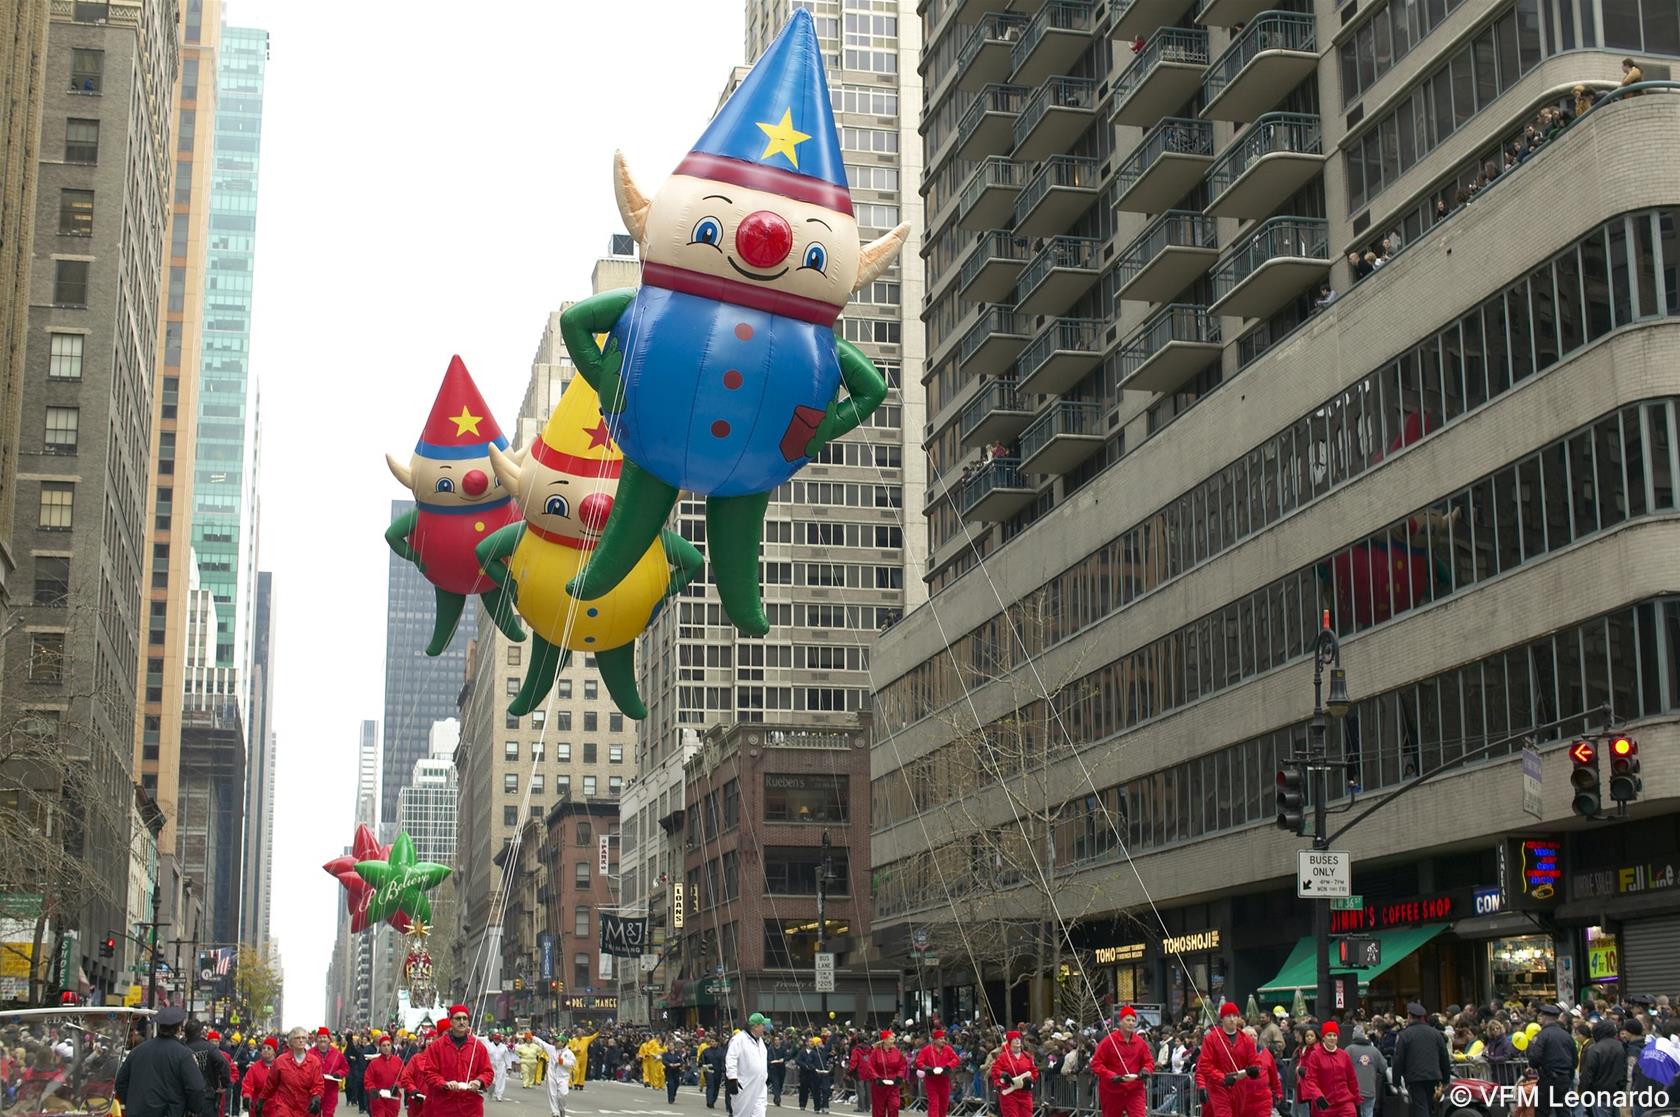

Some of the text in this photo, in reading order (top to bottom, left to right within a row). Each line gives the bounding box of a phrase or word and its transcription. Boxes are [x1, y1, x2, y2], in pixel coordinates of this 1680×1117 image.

[1309, 855, 1339, 865] BUSES
[1312, 867, 1336, 877] ONLY
[378, 867, 430, 905] Believe
[1619, 865, 1645, 893] Full
[1331, 898, 1451, 932] JIMMY'S COFFEE SHOP
[1345, 897, 1354, 908] 36
[605, 919, 643, 945] M&J
[1095, 947, 1116, 963] TOHO
[1163, 932, 1211, 954] TOHOSHOJI
[59, 941, 68, 988] SHOES
